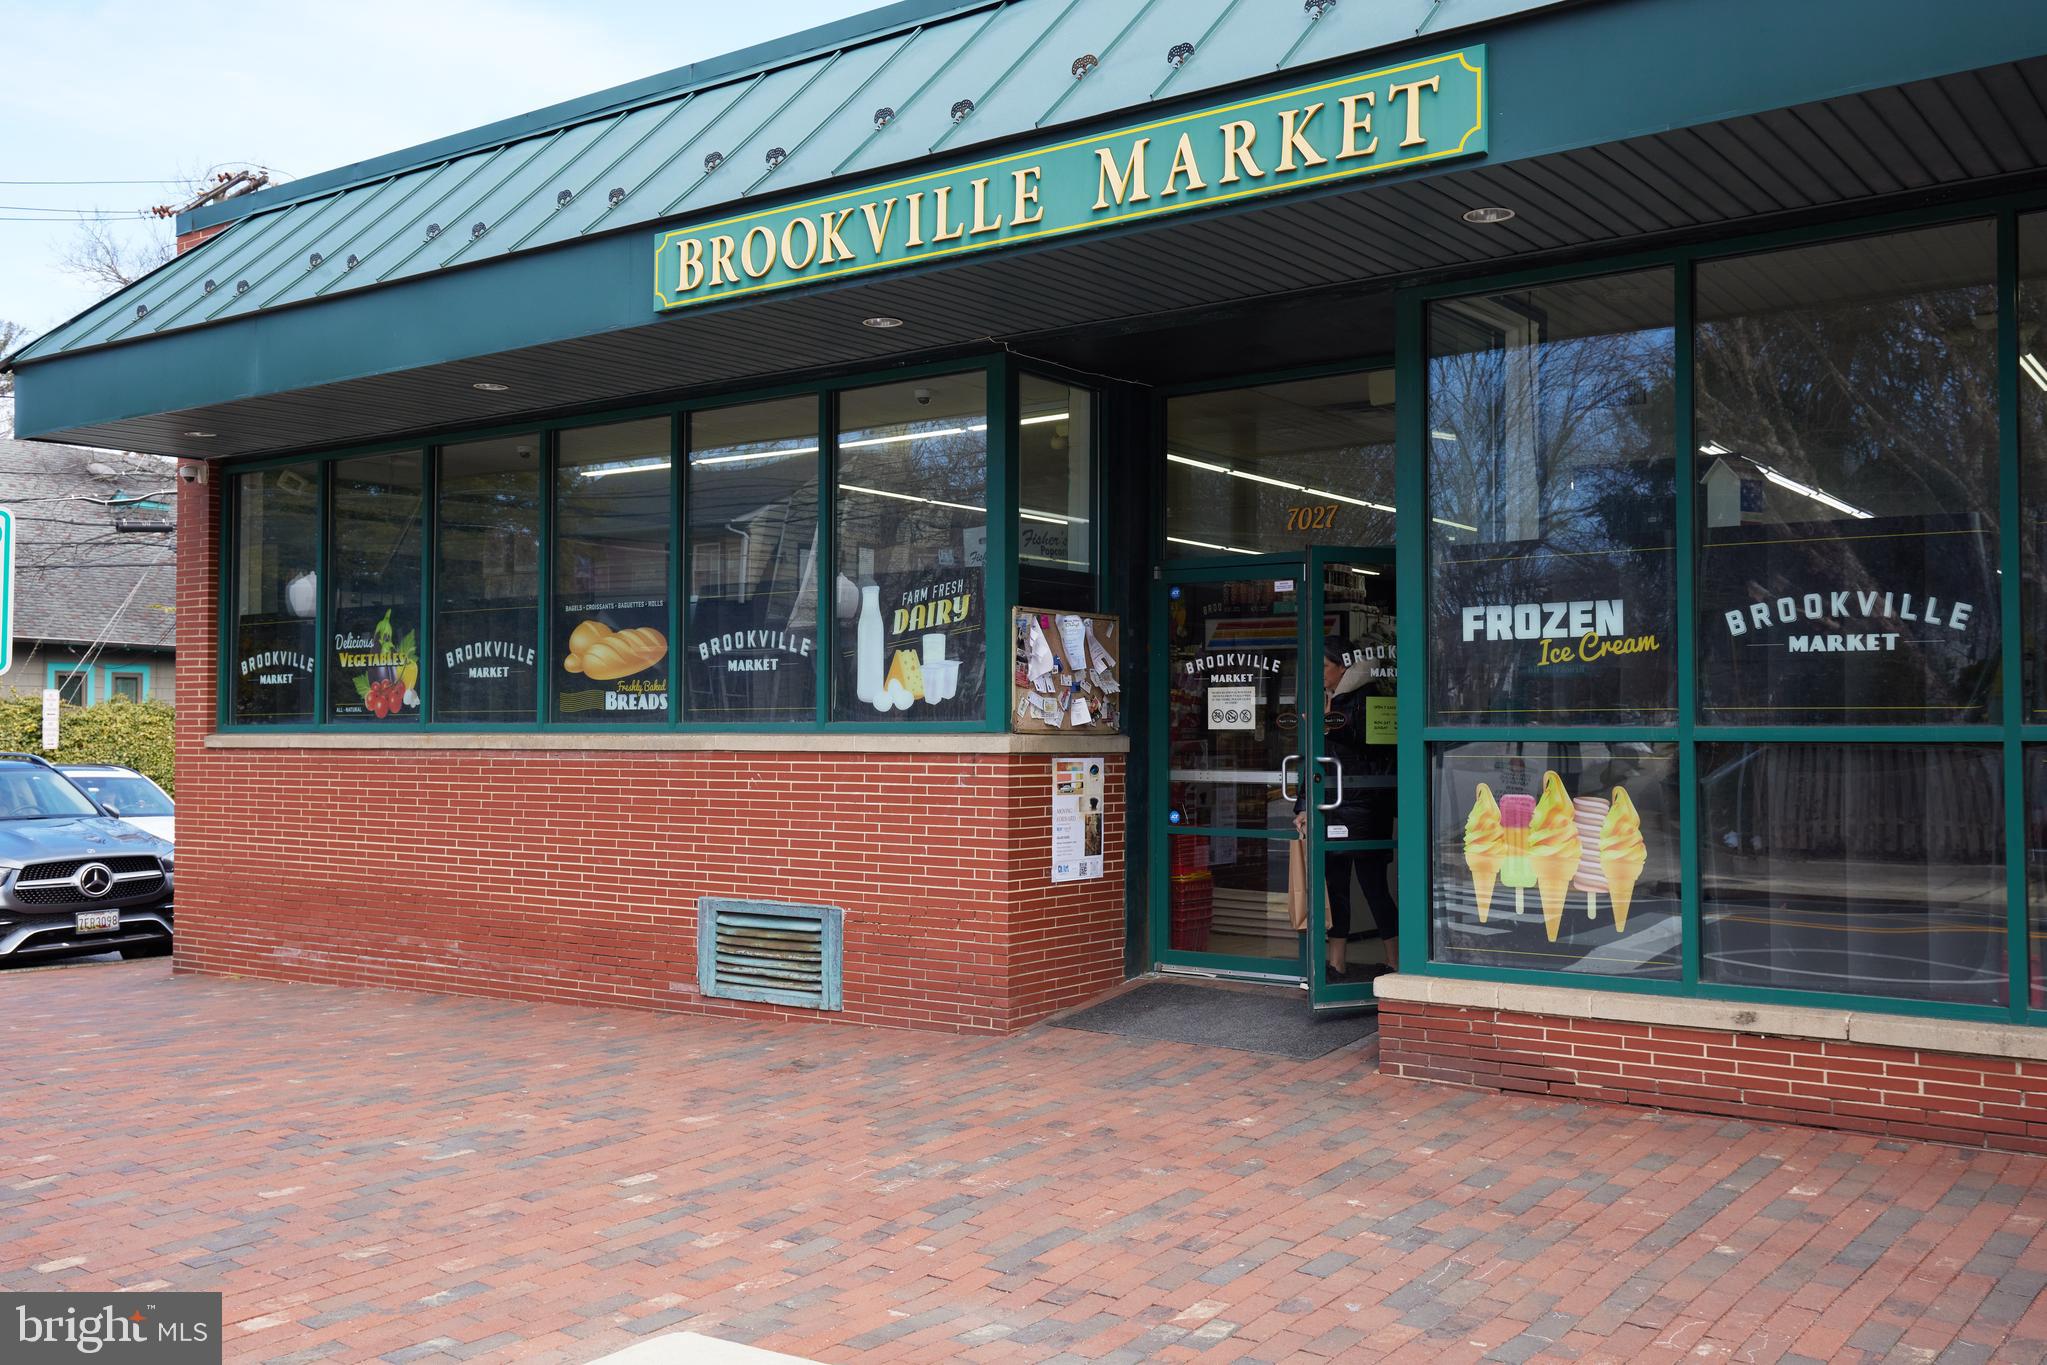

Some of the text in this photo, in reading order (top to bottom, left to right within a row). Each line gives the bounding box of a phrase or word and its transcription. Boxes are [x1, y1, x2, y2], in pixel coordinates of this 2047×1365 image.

[675, 75, 1441, 293] BROOKVILLE MARKET
[1286, 504, 1340, 532] 7027
[902, 579, 964, 606] FARM FRESH
[586, 603, 615, 611] CROISSANTS
[617, 601, 645, 609] BAGUETTES
[893, 593, 971, 635] DAIRY
[1725, 590, 1973, 637] BROOKVILLE
[1462, 599, 1624, 643] FROZEN
[335, 632, 374, 650] Delicious
[699, 629, 811, 660] BROOKVILLE
[1537, 632, 1660, 667] Ice Cream
[1788, 632, 1900, 653] MARKET
[241, 651, 315, 675] BROOKVILLE
[339, 653, 406, 668] VEGETABLES
[446, 640, 536, 669] BROOKVILLE
[728, 658, 779, 672] MARKET
[1186, 654, 1281, 674] BROOKVILLE
[259, 673, 293, 685] MARKET
[468, 666, 510, 679] MARKET
[1211, 674, 1254, 683] MARKET
[616, 679, 666, 696] Freshly Baked
[605, 691, 668, 711] BREADS
